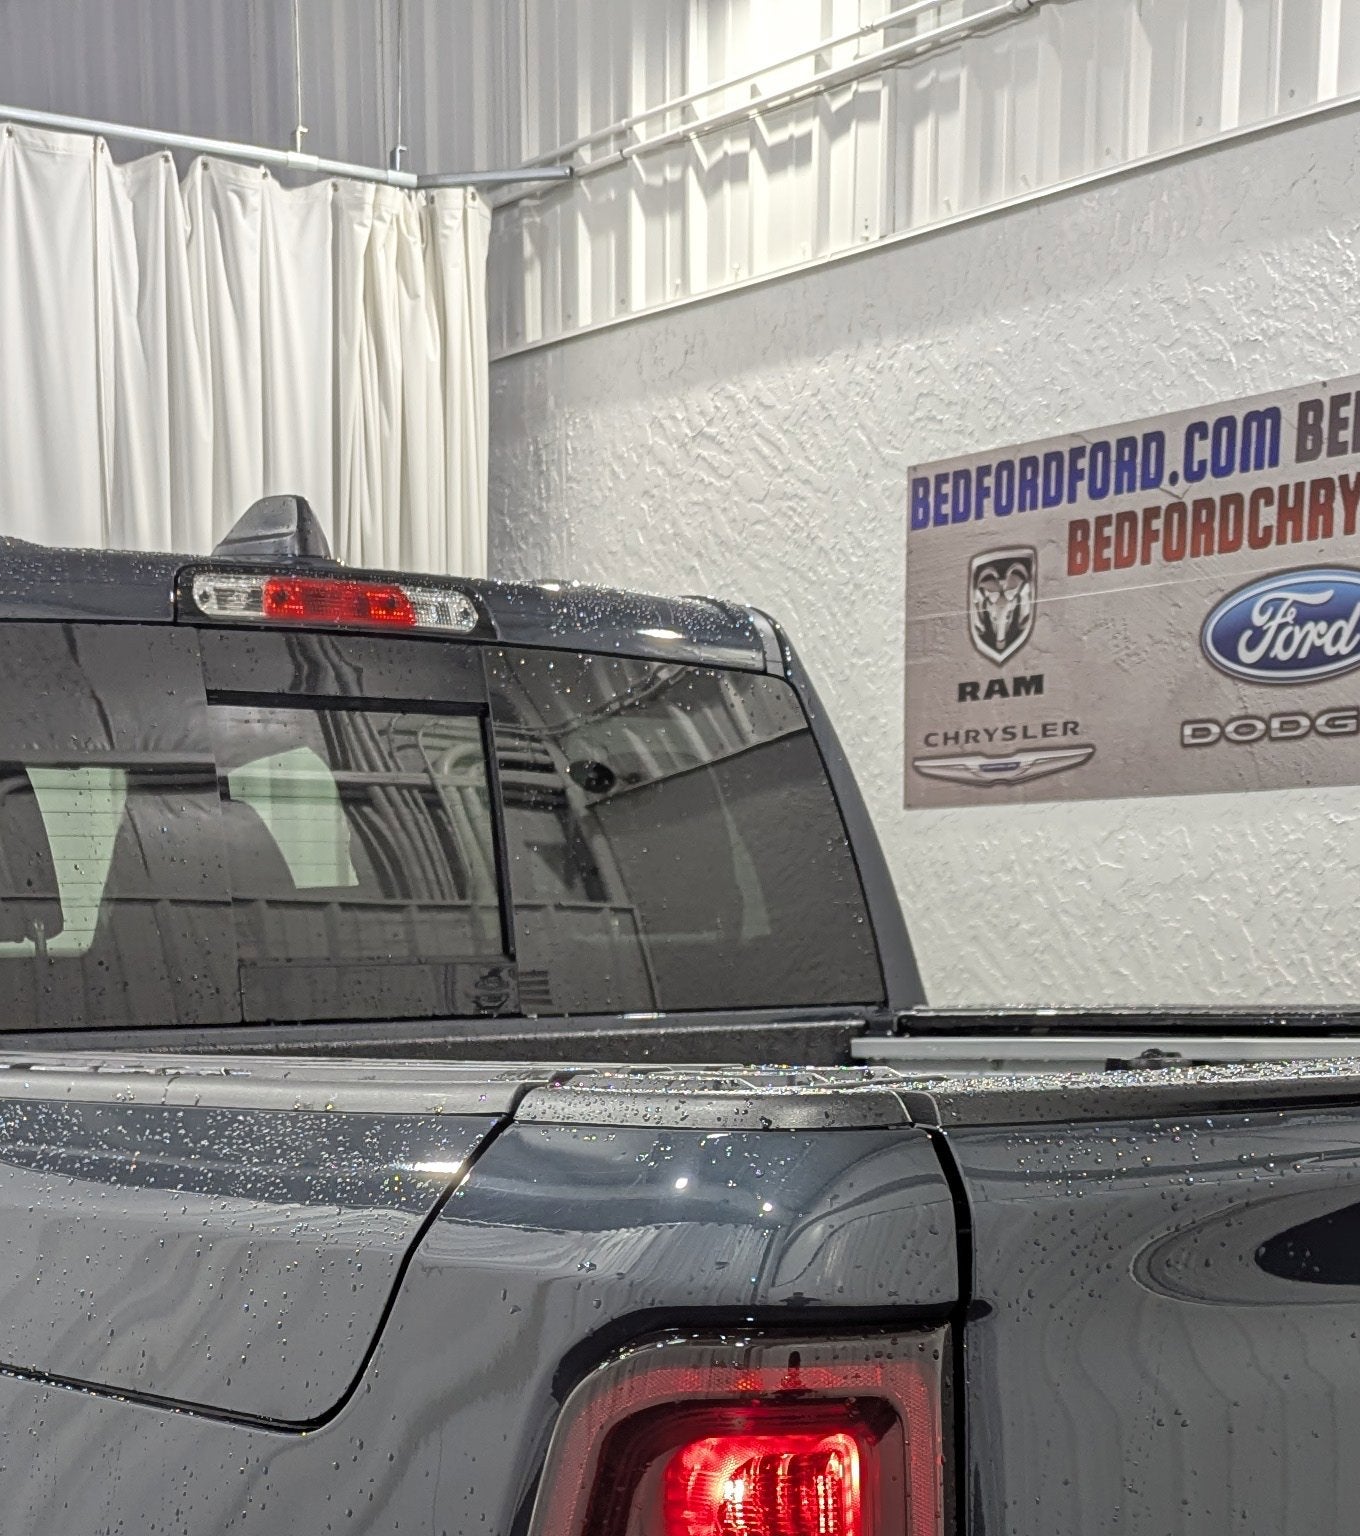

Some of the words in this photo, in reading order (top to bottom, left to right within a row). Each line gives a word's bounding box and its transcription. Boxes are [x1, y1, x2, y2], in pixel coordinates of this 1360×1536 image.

[910, 406, 1282, 531] BEDFORDFORD.COM
[958, 673, 1045, 703] RAM
[923, 720, 1081, 748] CHRYSLER
